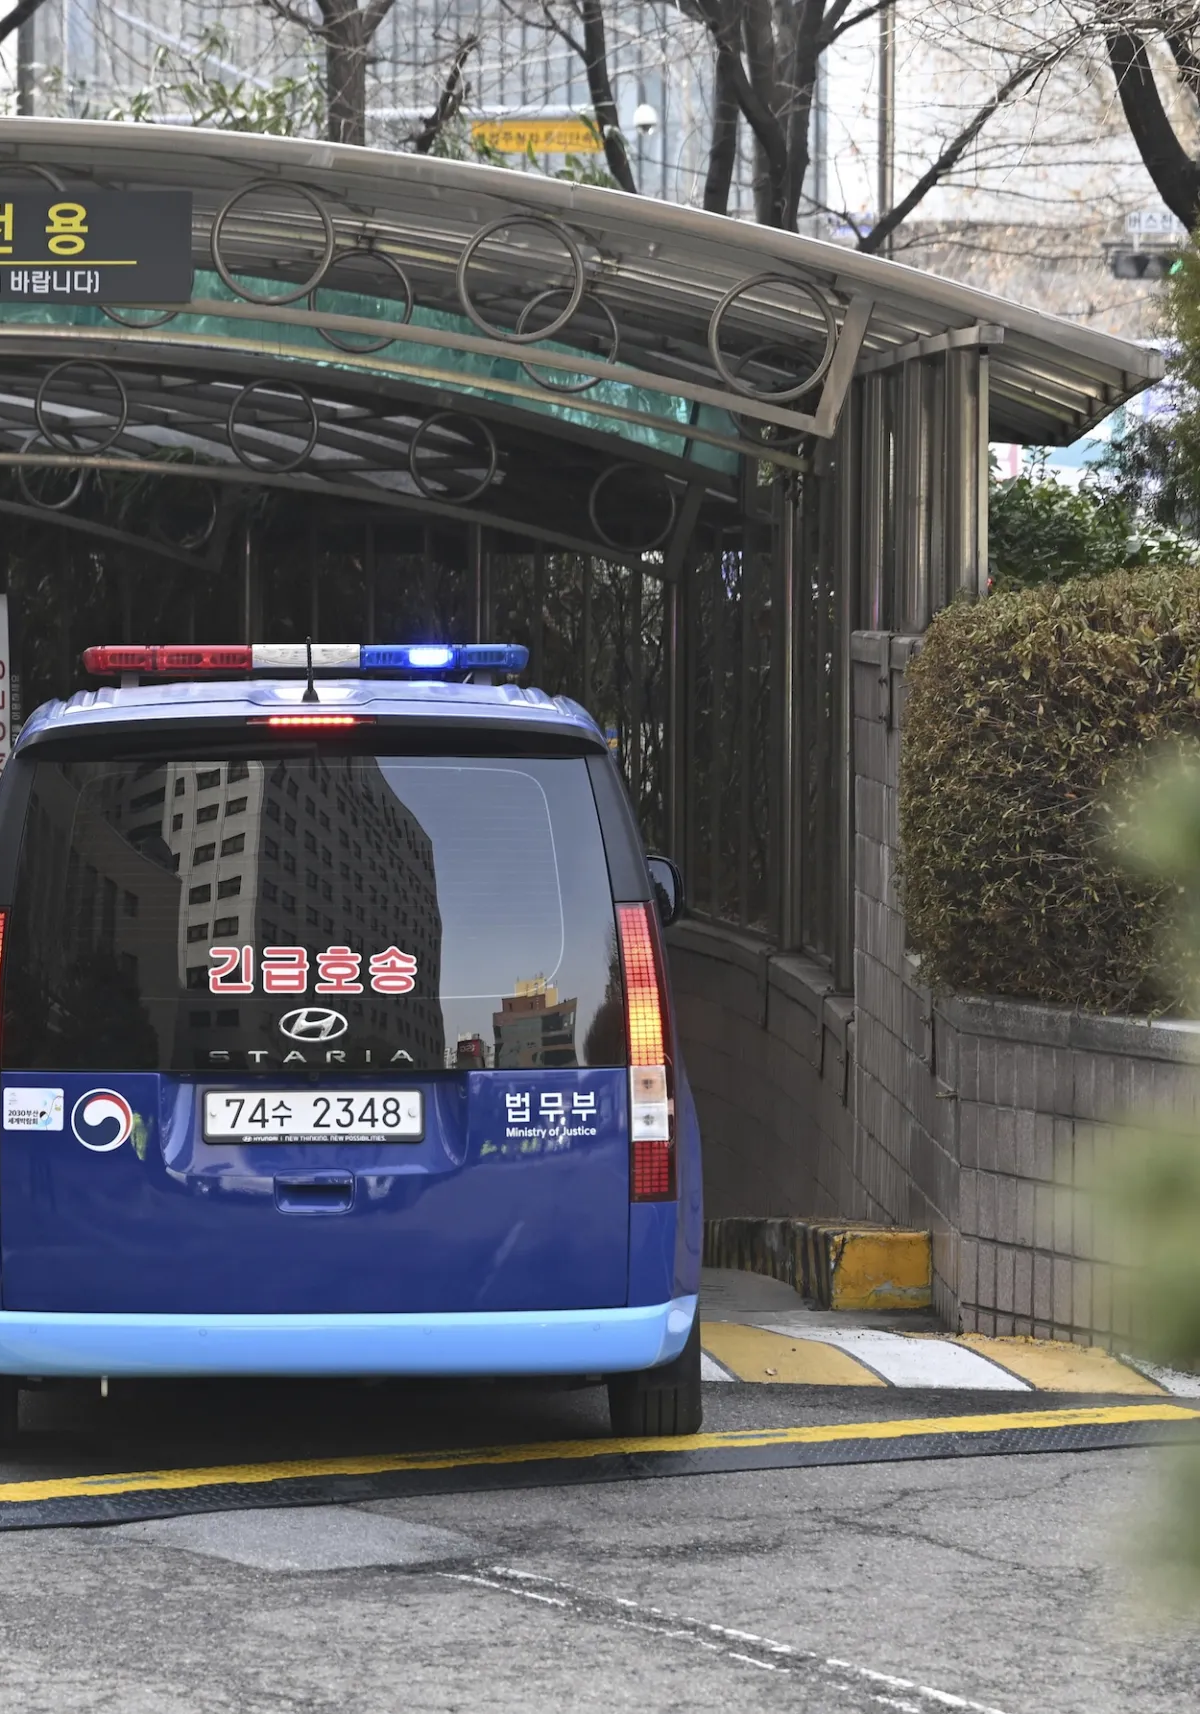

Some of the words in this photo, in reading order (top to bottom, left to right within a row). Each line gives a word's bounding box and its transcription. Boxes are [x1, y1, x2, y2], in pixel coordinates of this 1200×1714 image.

[11, 270, 100, 294] 바랍니다]
[208, 945, 418, 994] 긴급호송
[209, 1050, 414, 1063] STARIA
[225, 1098, 293, 1129] 74수
[312, 1097, 401, 1128] 2348
[505, 1091, 597, 1122] 법무부
[506, 1127, 546, 1138] Ministry
[549, 1126, 560, 1136] of
[561, 1125, 597, 1136] Justice
